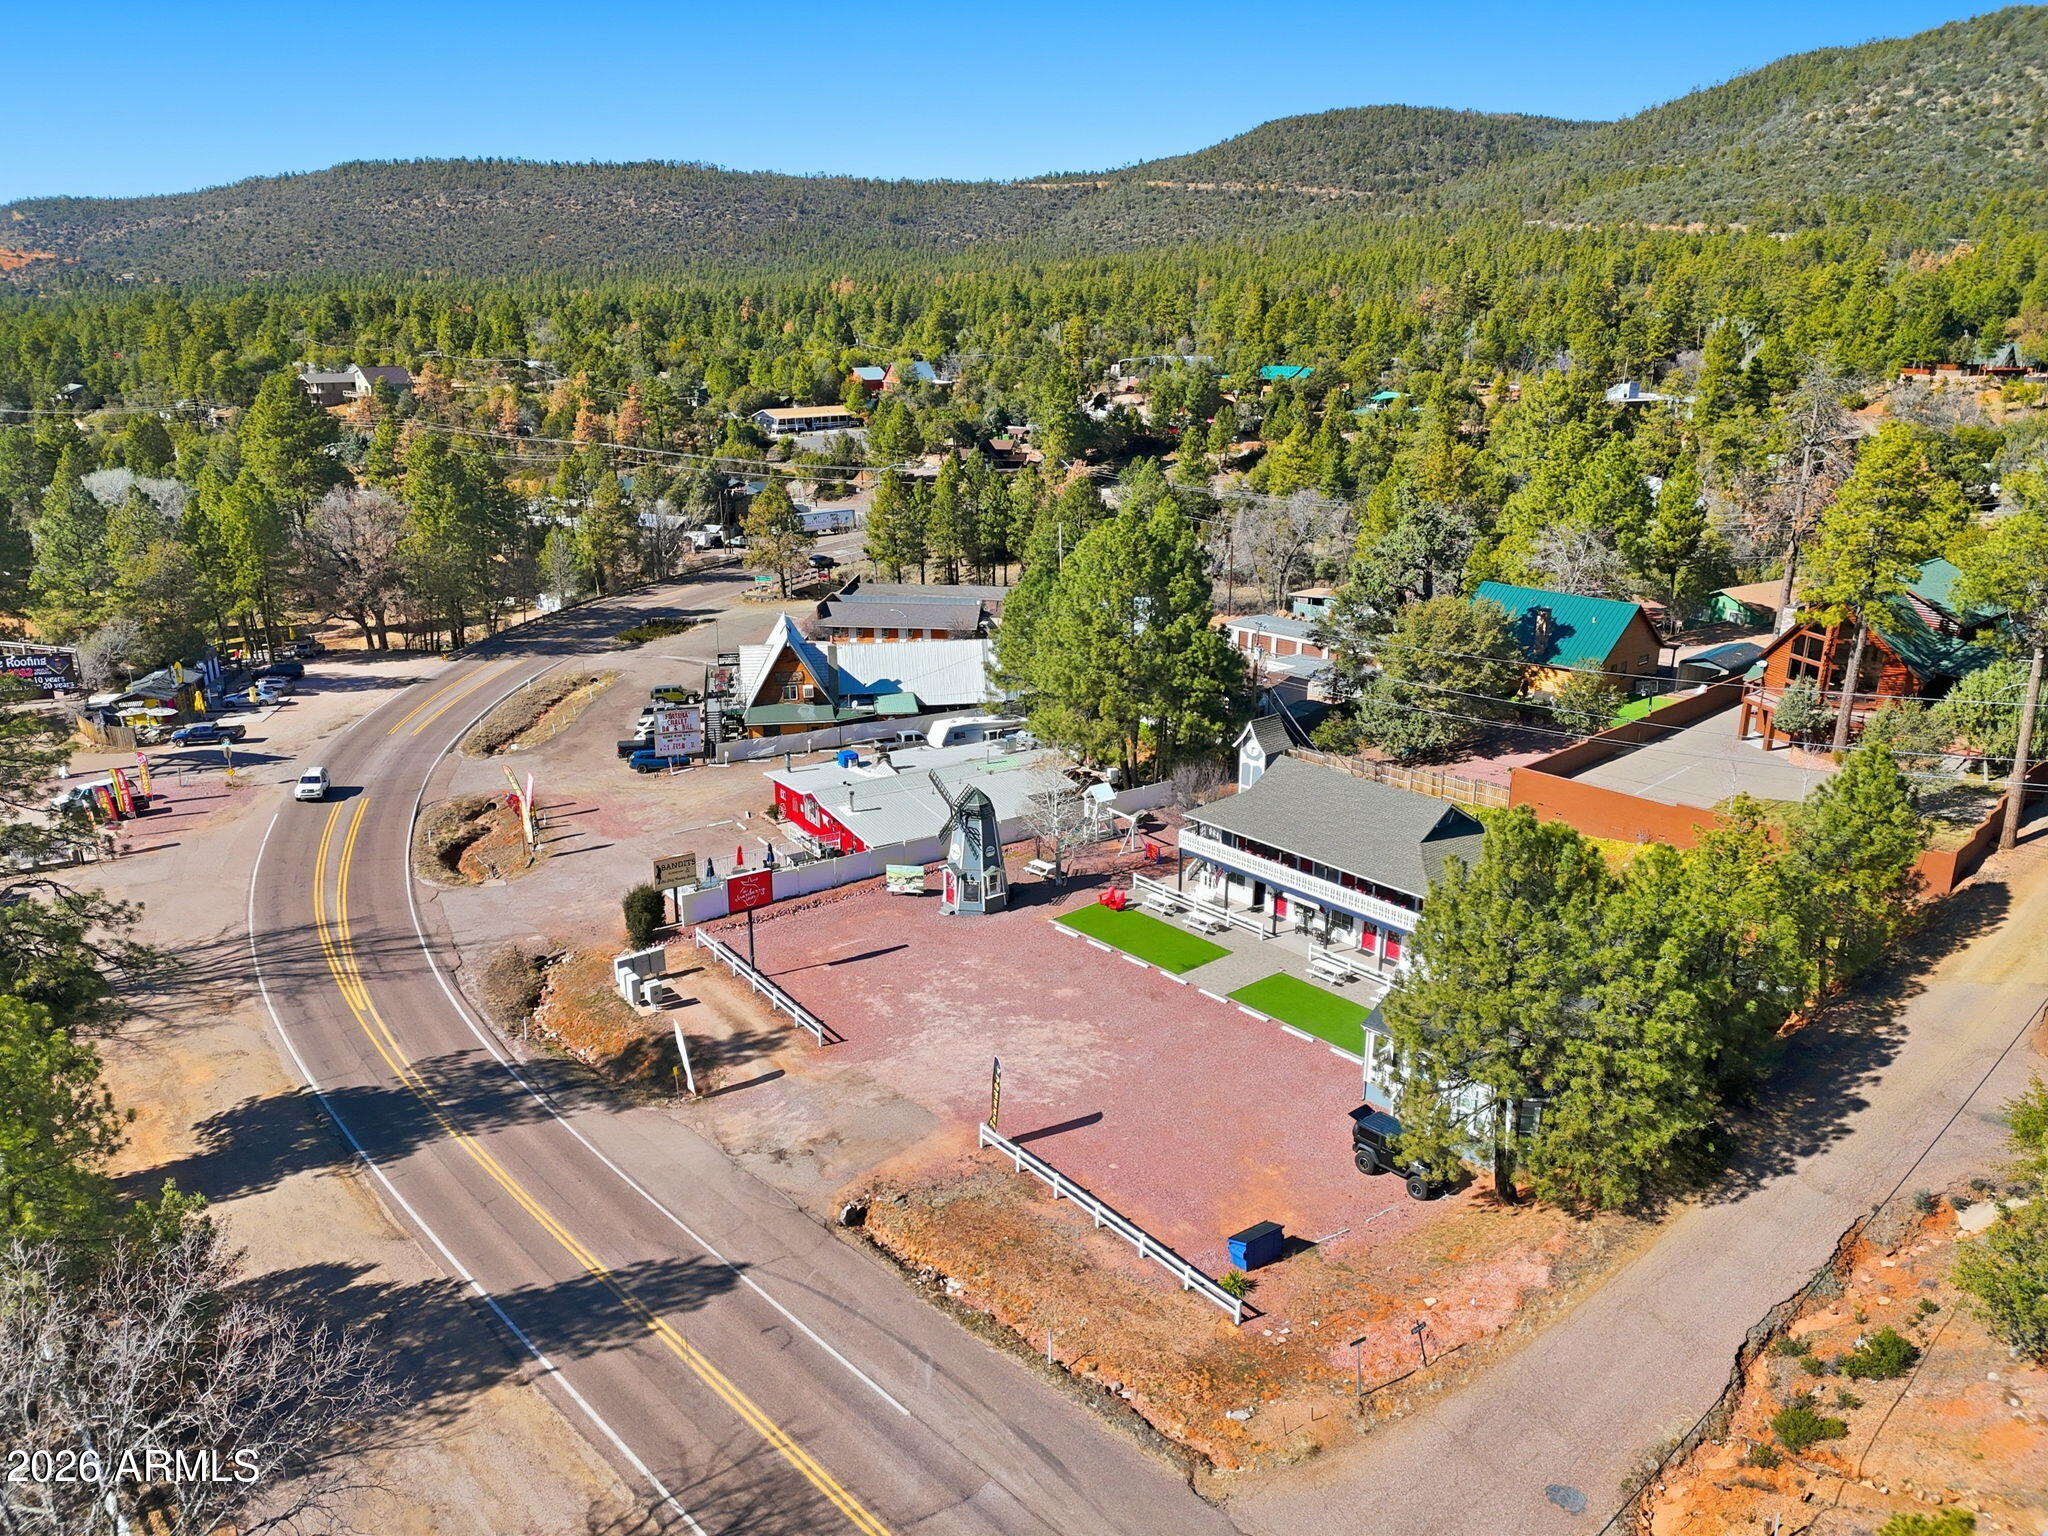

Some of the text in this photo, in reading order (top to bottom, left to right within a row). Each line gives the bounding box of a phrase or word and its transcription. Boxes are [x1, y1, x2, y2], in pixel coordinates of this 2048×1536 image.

[6, 656, 47, 668] Roofing
[34, 676, 43, 684] 10
[43, 681, 75, 690] 20 years
